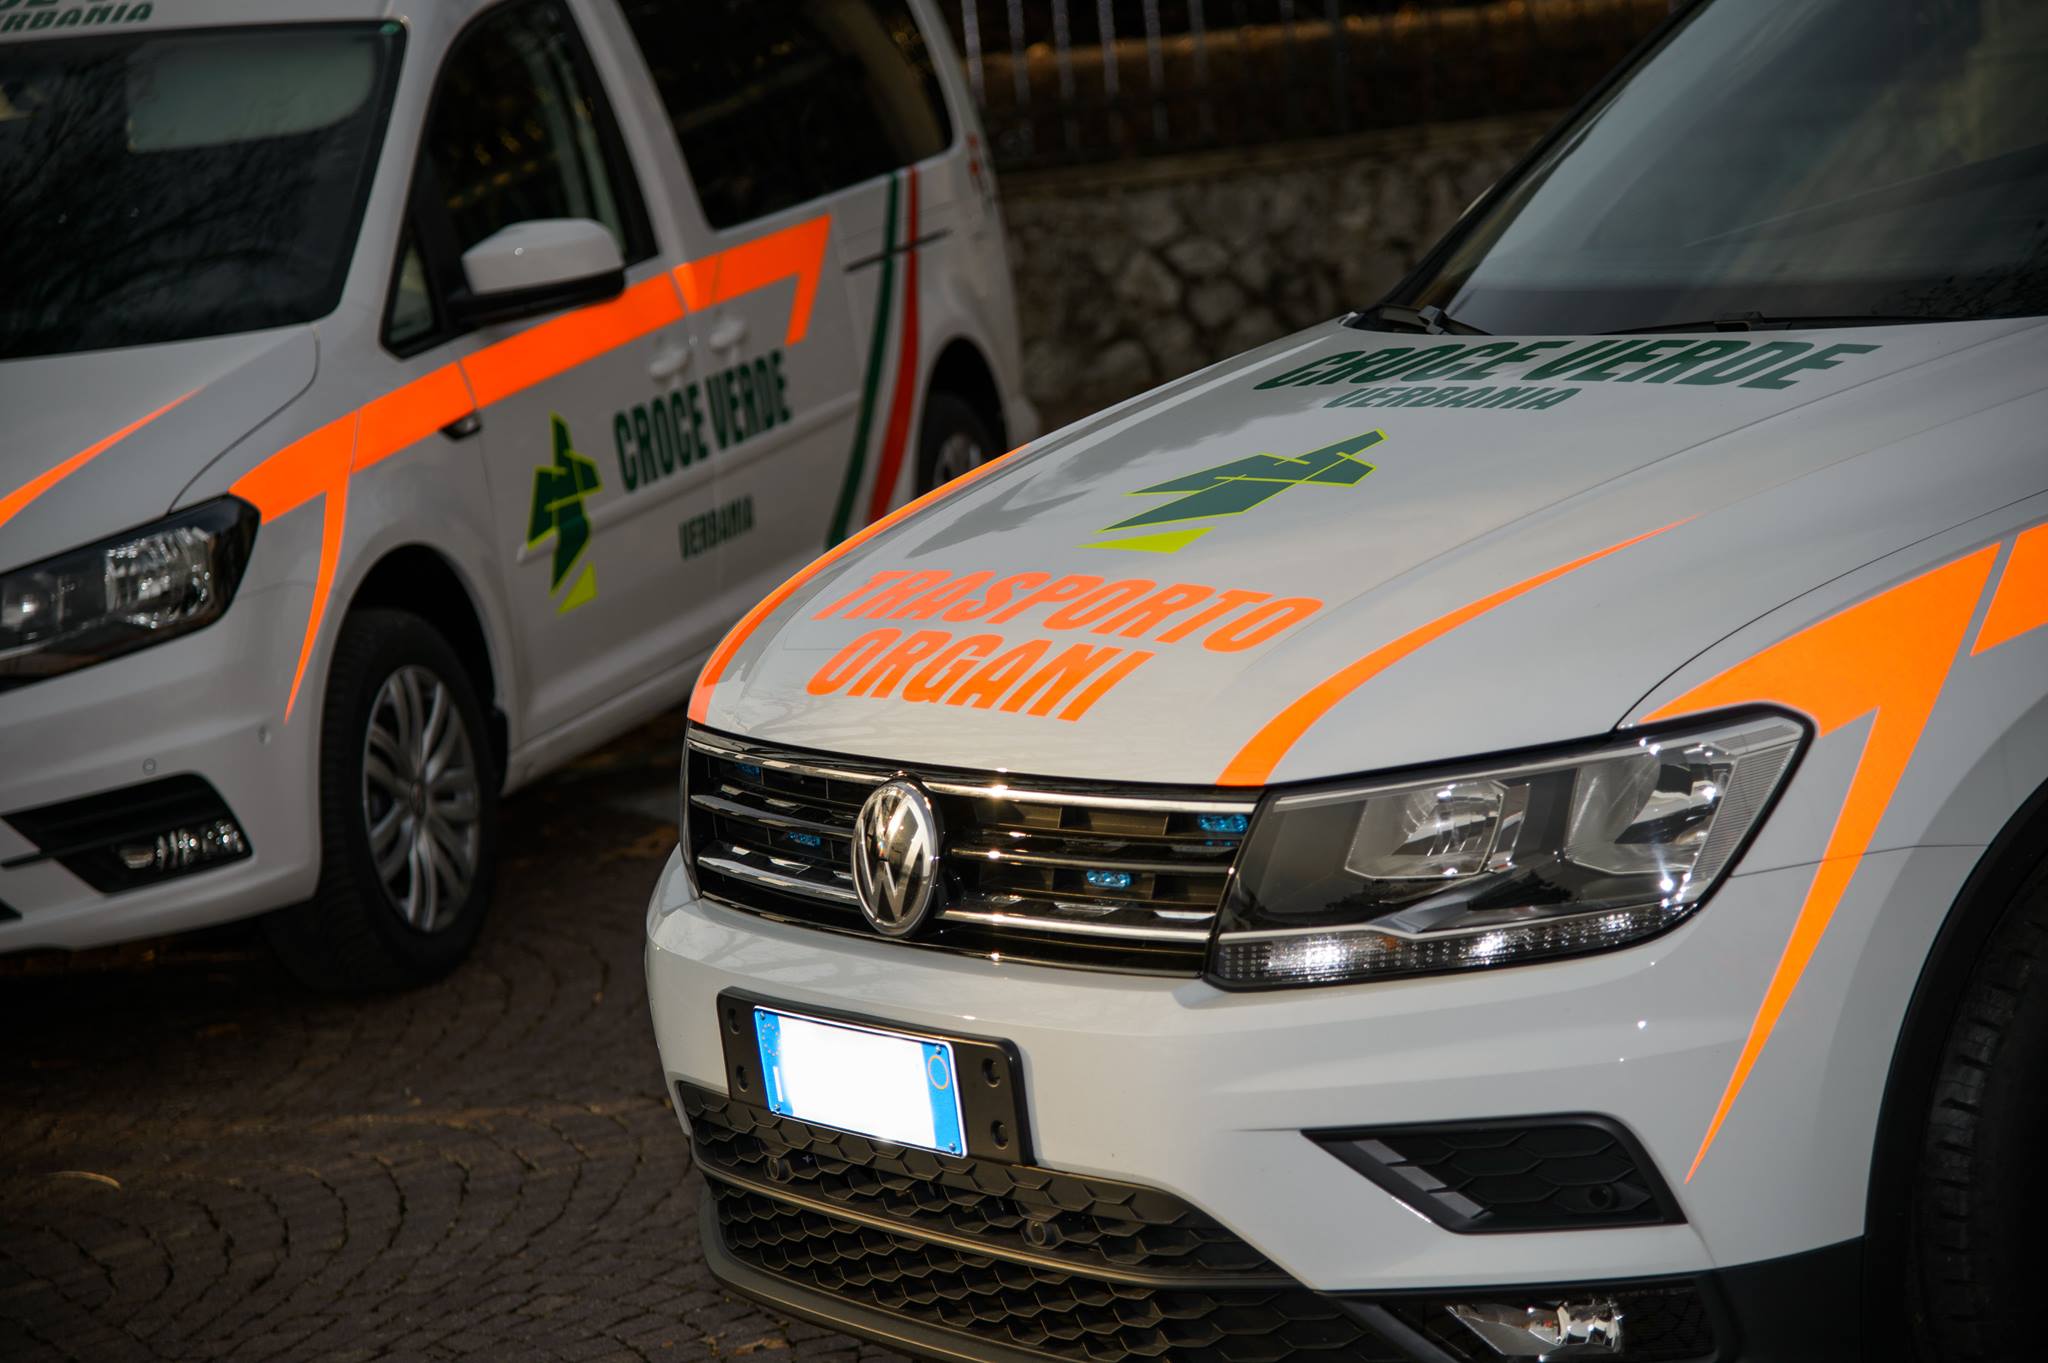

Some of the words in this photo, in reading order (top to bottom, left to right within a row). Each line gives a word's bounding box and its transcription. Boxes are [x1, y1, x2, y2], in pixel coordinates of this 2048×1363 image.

[0, 3, 154, 33] RBANIA
[1253, 339, 1575, 392] CROCE
[1520, 339, 1882, 391] VERDE
[1323, 385, 1582, 411] VERBANIA
[612, 383, 709, 494] CROCE
[705, 349, 792, 451] VERDE
[810, 569, 1325, 653] TRASPORTO
[805, 627, 1157, 723] ORGANI
